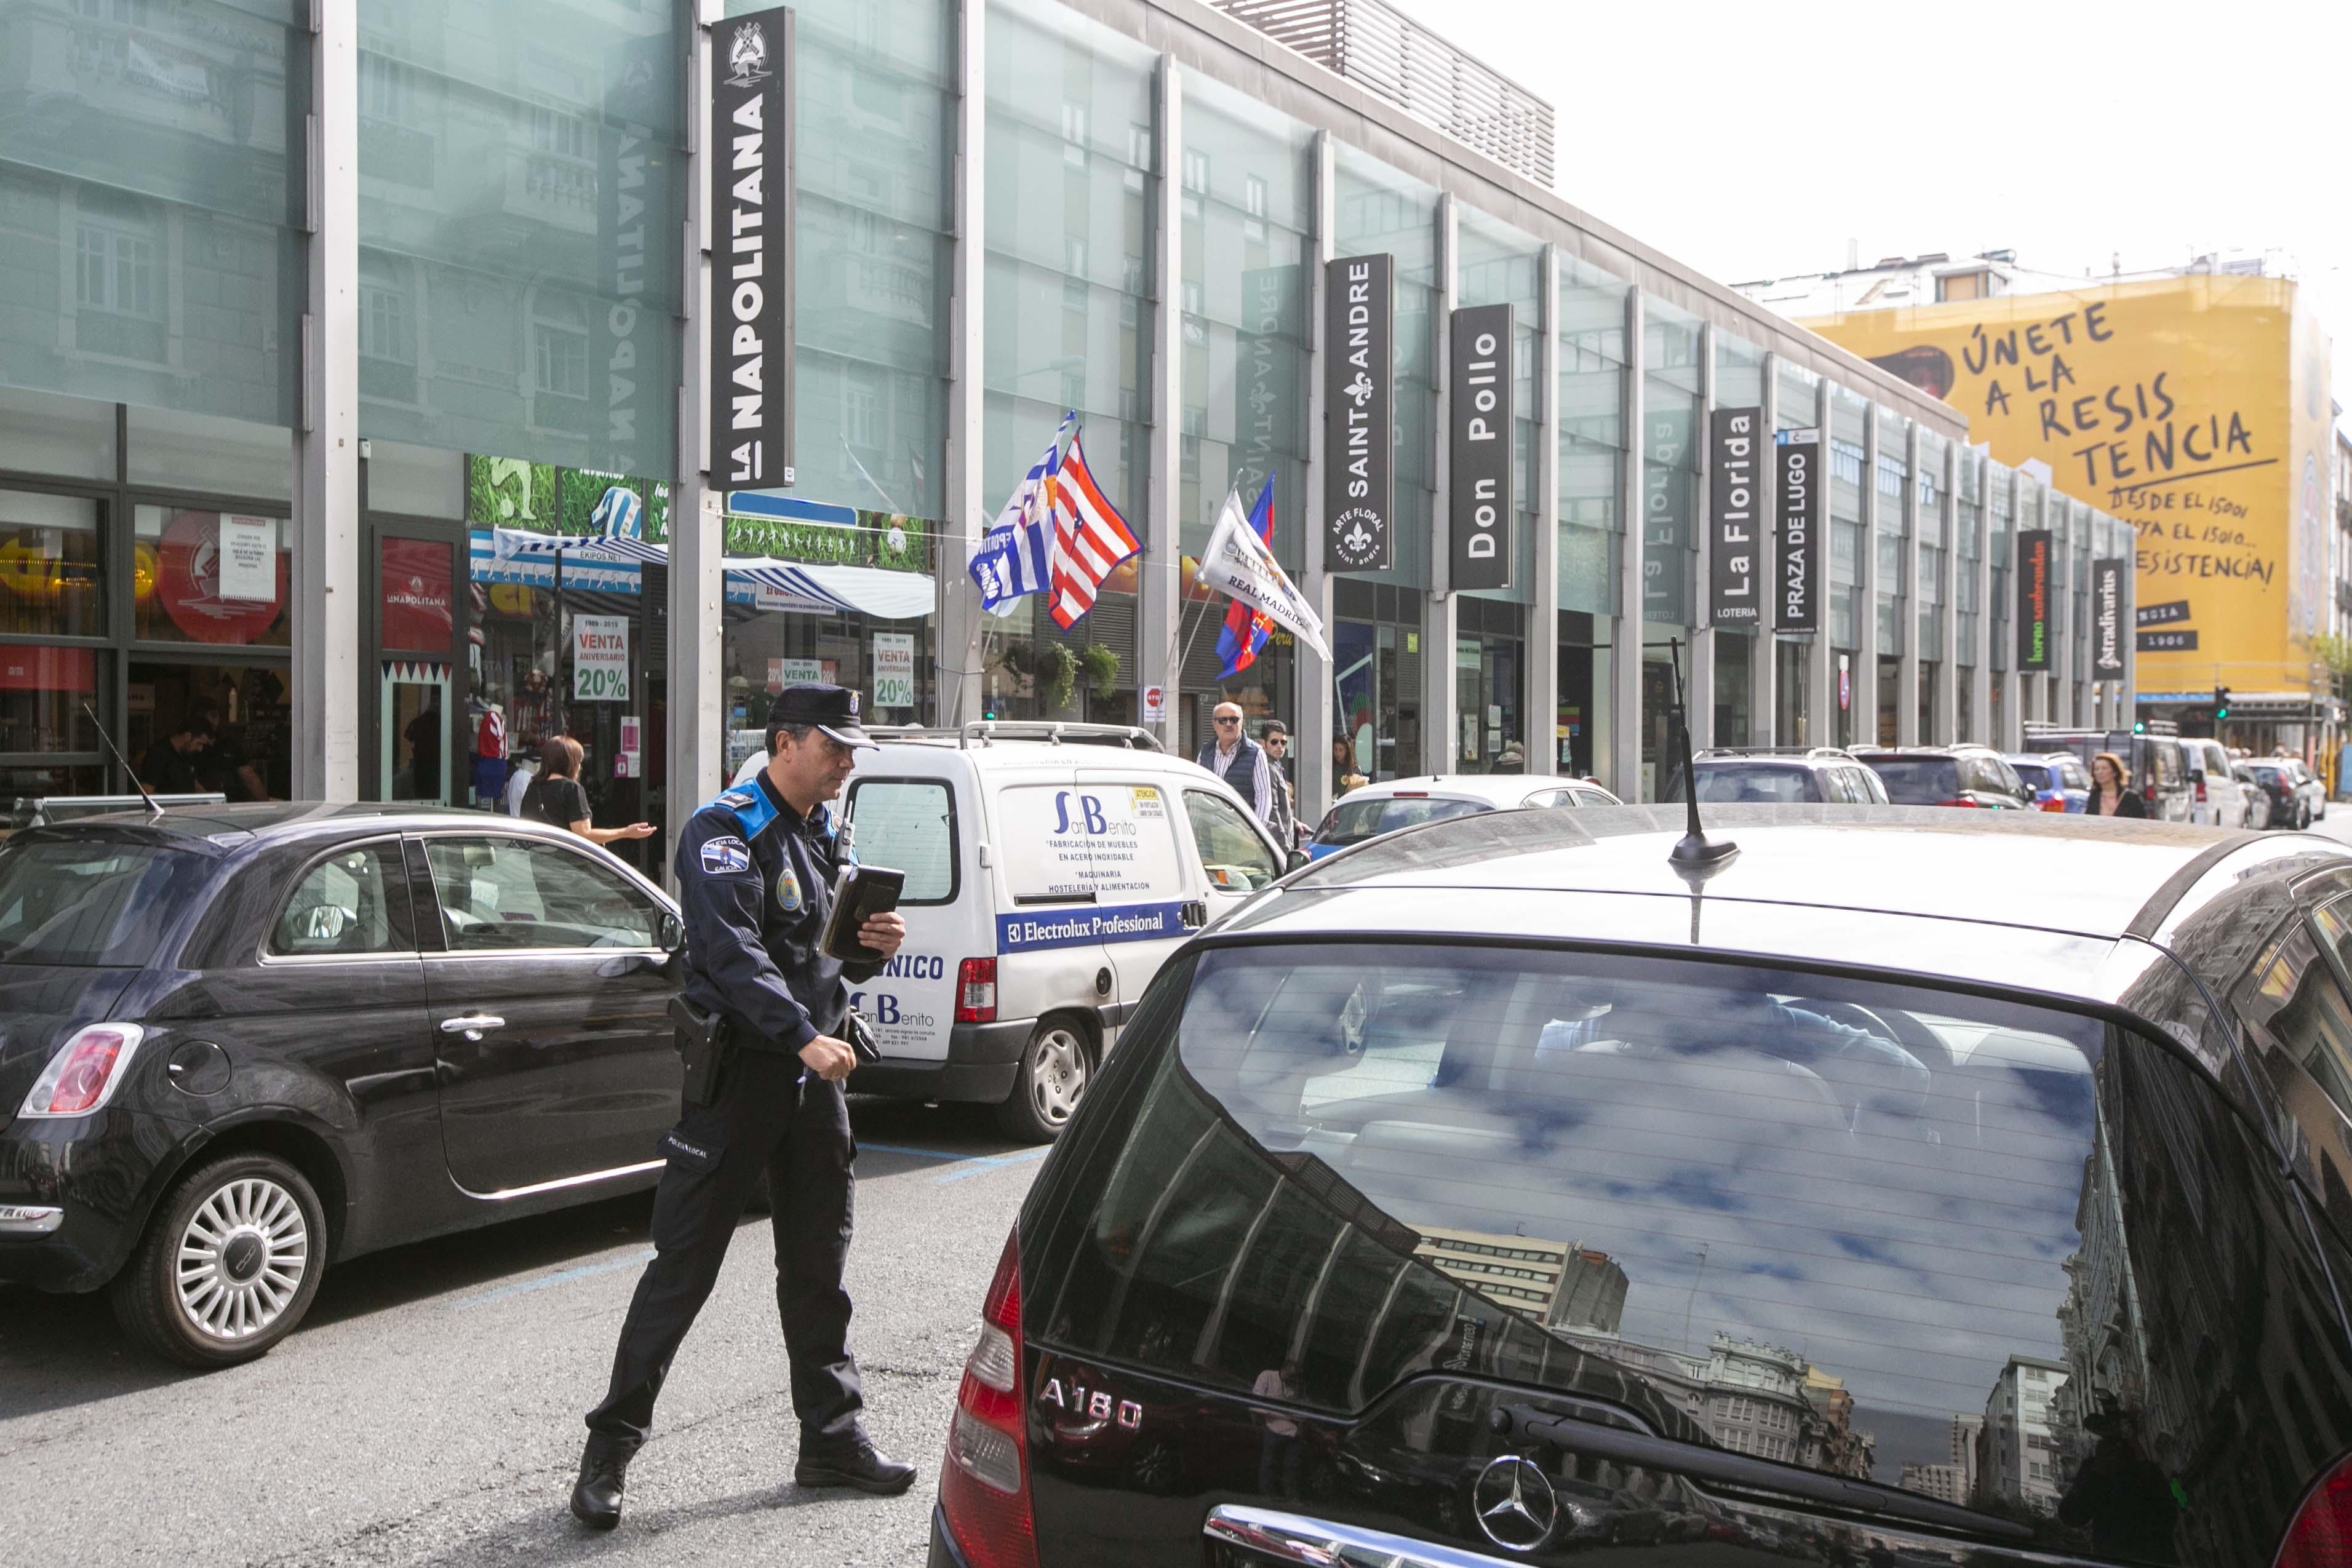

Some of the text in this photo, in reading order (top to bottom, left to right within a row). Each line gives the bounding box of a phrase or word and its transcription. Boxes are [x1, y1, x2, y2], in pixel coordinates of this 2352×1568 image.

[732, 92, 763, 482] LA NAPOLITANA
[1963, 301, 2113, 375] ÚNETE
[1349, 262, 1369, 498] SAINT ANDRE
[1985, 354, 2076, 416] A LA
[2040, 372, 2175, 442] RESIS
[1468, 333, 1496, 559] Don Pollo
[2073, 411, 2252, 487] TENCIA
[1788, 453, 1806, 511] LUGO
[1724, 415, 1750, 596] La Florida
[2110, 486, 2175, 511] DESDE
[2183, 491, 2204, 509] EL
[1332, 508, 1384, 535] ARTE FLORAL
[1788, 516, 1805, 544] DE
[2172, 523, 2195, 540] EL
[1335, 544, 1381, 565] saint andre
[1228, 576, 1258, 597] REAL
[1787, 548, 1805, 618] PRAZA
[1717, 608, 1757, 618] LOTERIA
[579, 634, 624, 650] VENTA
[878, 649, 911, 663] VENTA
[578, 668, 626, 698] 20%
[768, 668, 782, 685] 20%
[784, 669, 819, 680] VENTA
[822, 671, 836, 685] 20%
[877, 679, 912, 704] 20%
[1053, 791, 1137, 835] San Benito
[1101, 882, 1150, 891] ALIMENTACION
[1024, 912, 1163, 941] Electrolux Professional
[875, 955, 943, 979] NICO
[877, 994, 934, 1027] Benito
[689, 1147, 707, 1158] LOCAL
